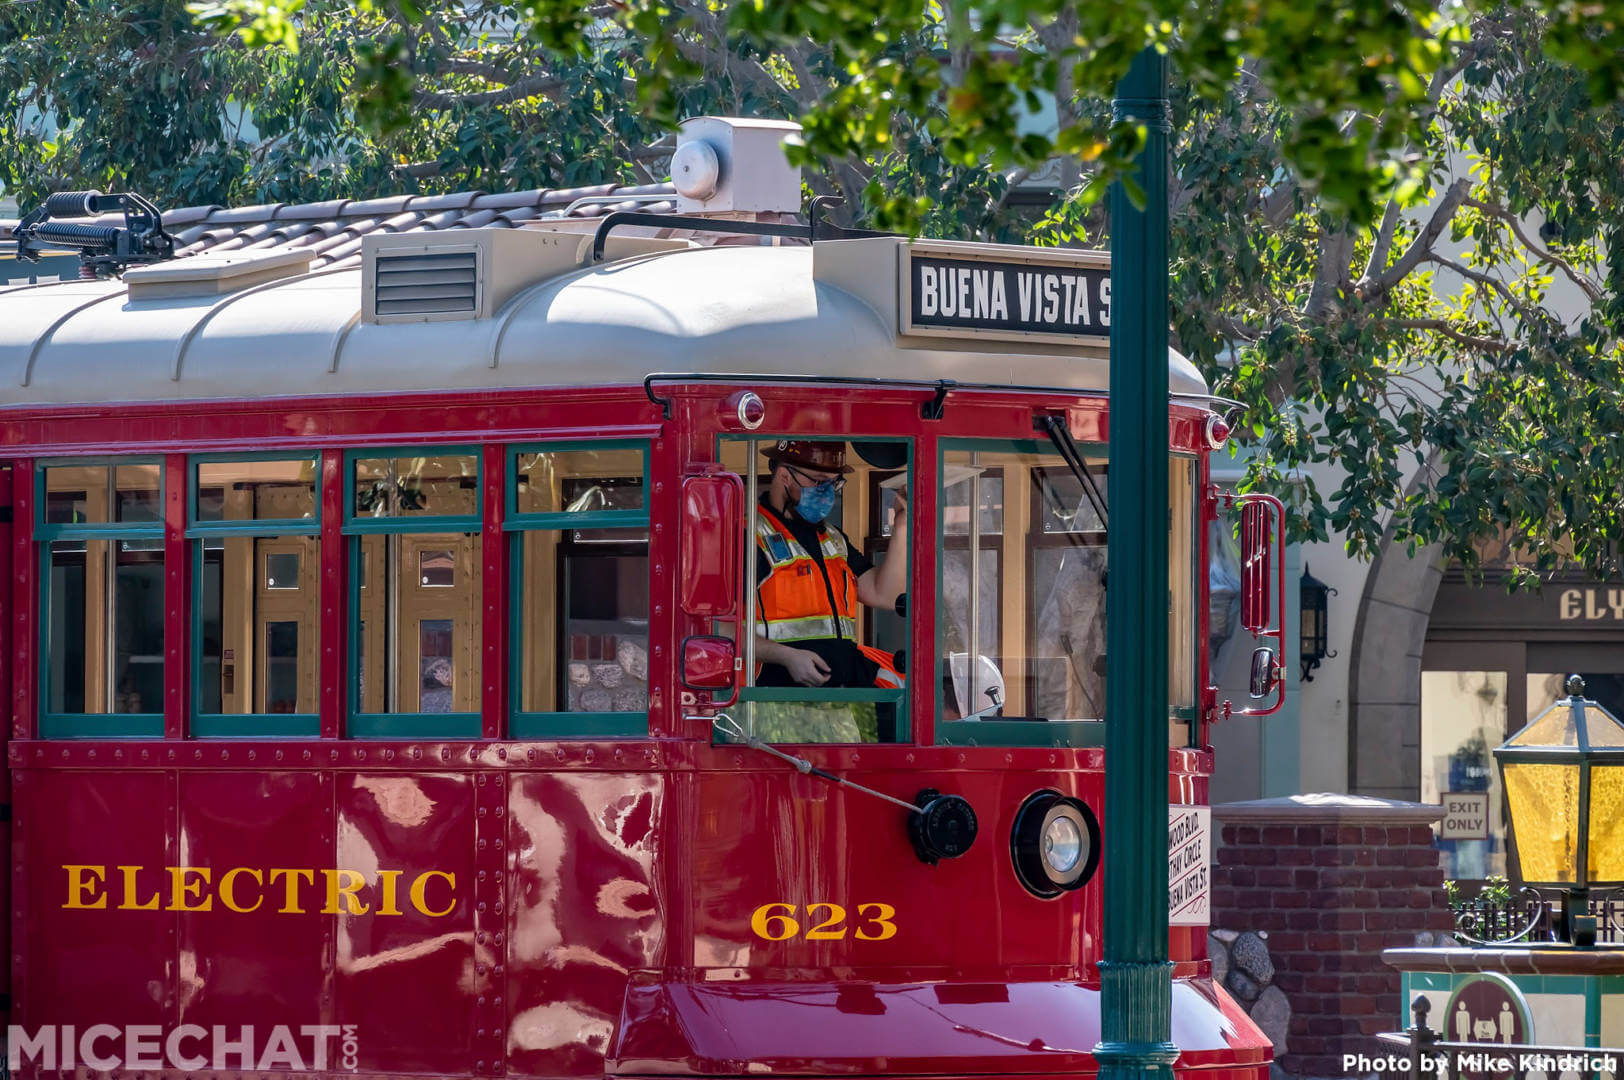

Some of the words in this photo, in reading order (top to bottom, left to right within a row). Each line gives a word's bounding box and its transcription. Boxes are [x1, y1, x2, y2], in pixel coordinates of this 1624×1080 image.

[920, 265, 1008, 320] BUENA
[1017, 272, 1091, 326] VISTA
[1449, 802, 1480, 813] EXIT
[1446, 819, 1482, 830] ONLY
[1184, 840, 1201, 868] CIRCLE
[61, 864, 457, 918] ELECTRIC
[1185, 873, 1199, 899] VISTA
[751, 902, 898, 941] 623
